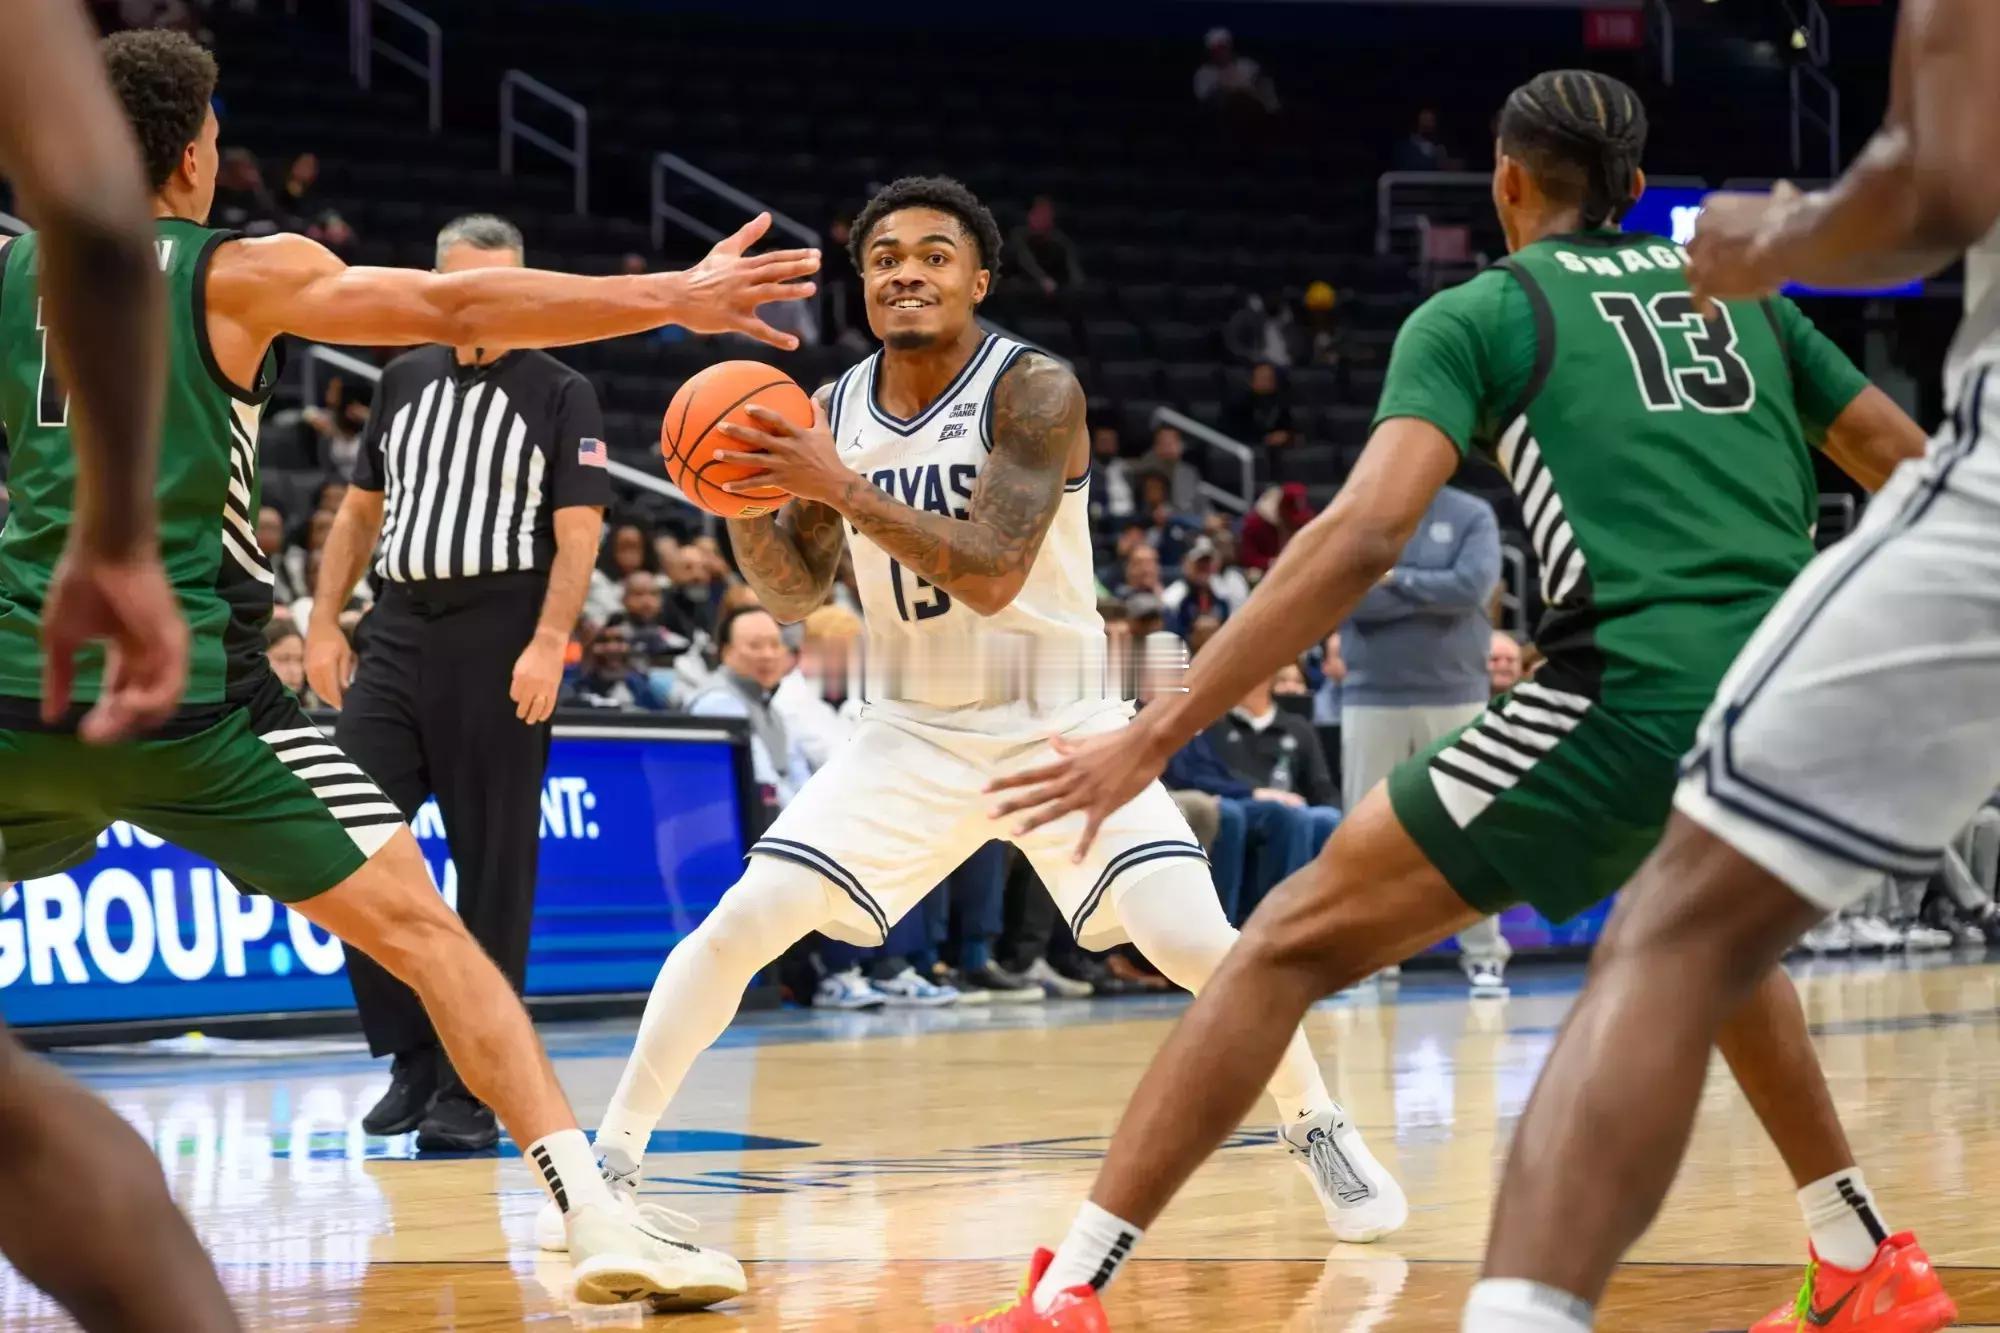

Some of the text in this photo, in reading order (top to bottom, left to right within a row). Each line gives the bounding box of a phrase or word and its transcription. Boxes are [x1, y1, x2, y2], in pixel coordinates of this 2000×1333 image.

[1591, 291, 1756, 414] 13
[953, 402, 978, 411] BE THE
[949, 410, 976, 418] CHANGE
[942, 423, 964, 431] BIG
[939, 429, 968, 439] EAST
[854, 464, 977, 528] OYAS
